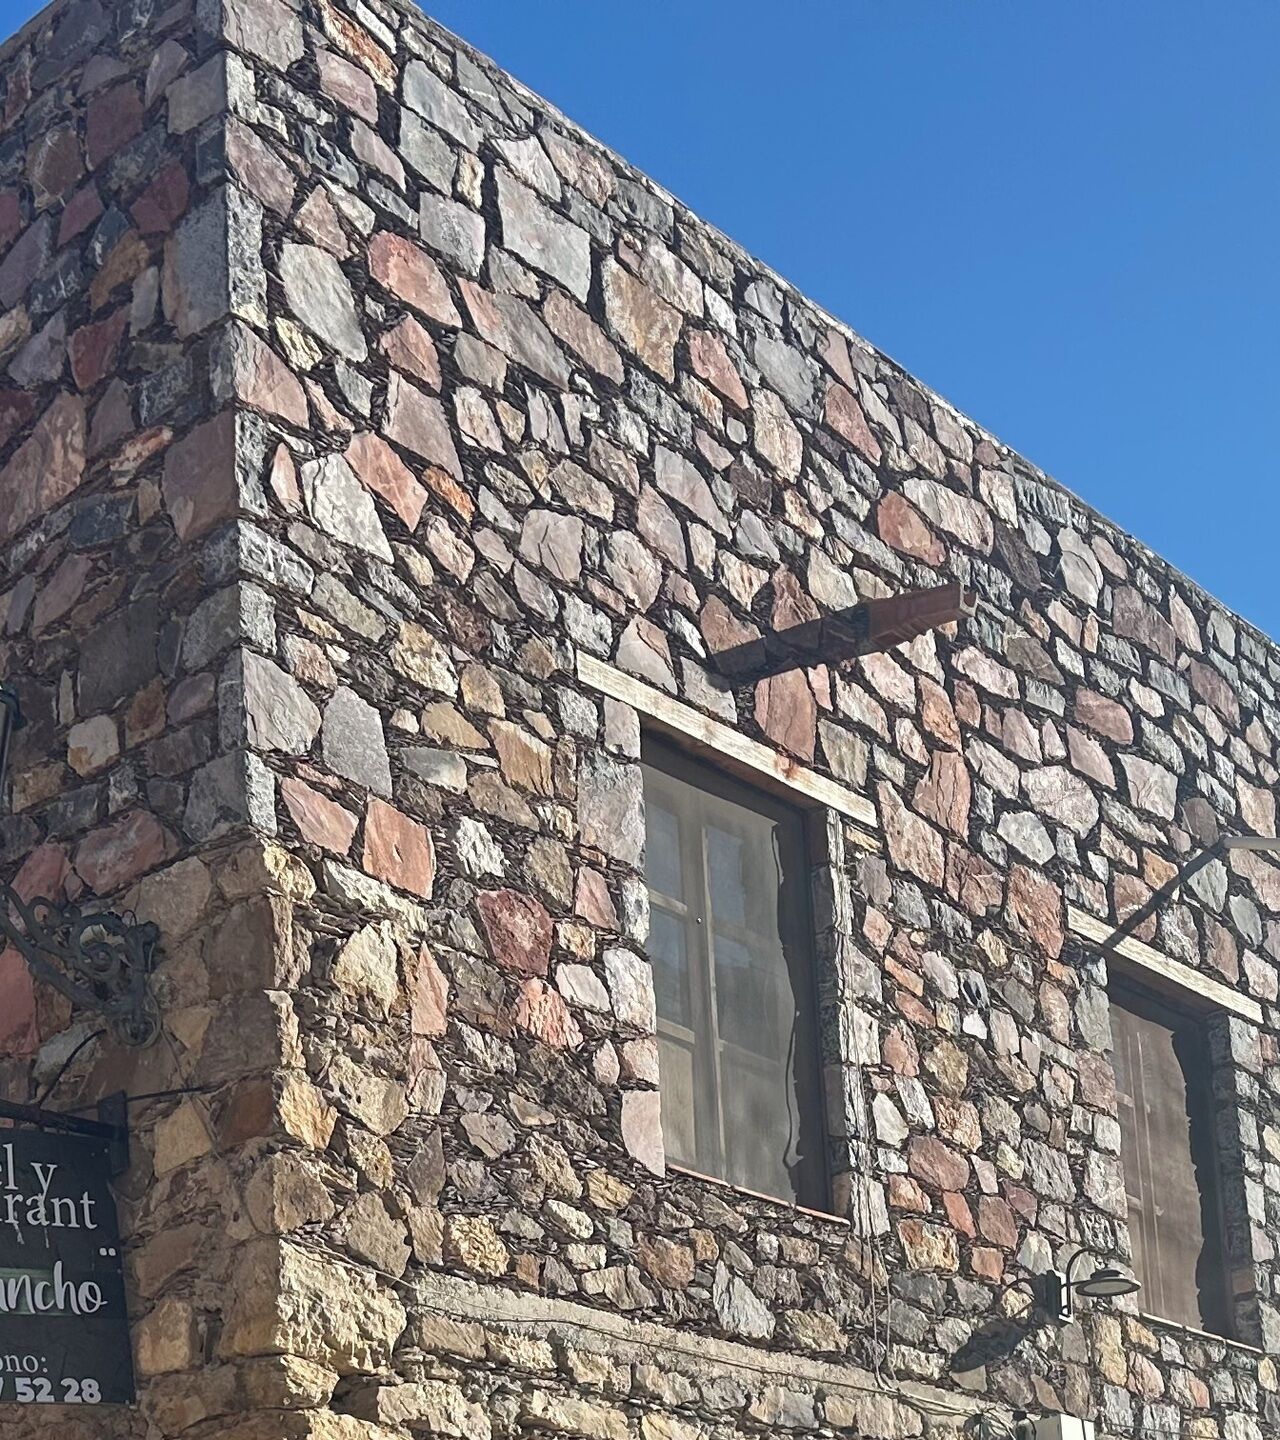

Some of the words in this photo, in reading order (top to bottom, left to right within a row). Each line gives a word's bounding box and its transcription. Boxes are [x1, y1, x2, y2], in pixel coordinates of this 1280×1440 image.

[30, 1161, 58, 1199] y
[15, 1377, 54, 1402] 52
[60, 1378, 102, 1404] 28
